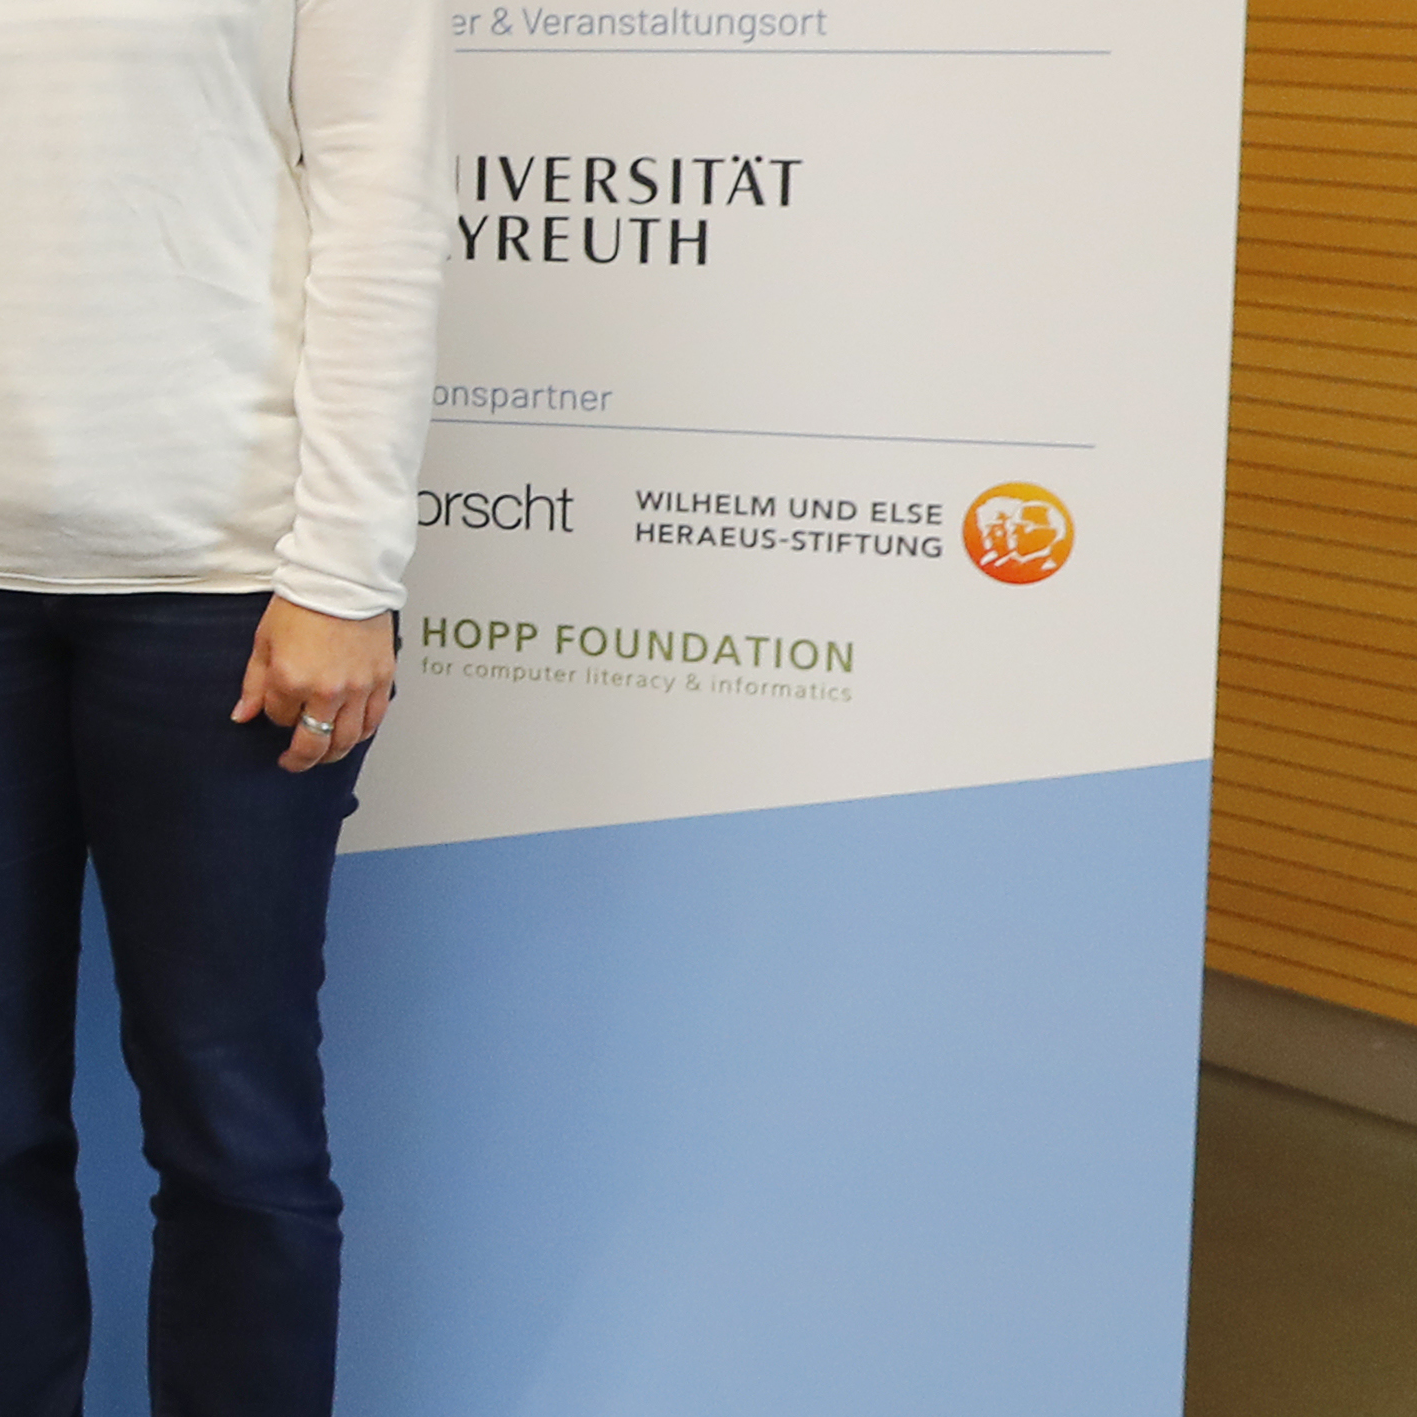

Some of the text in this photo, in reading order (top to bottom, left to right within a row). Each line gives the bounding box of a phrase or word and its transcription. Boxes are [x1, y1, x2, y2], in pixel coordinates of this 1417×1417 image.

[490, 6, 514, 36] &
[521, 6, 828, 44] Veranstaltungsort
[456, 154, 802, 207] IVERSITÄT
[458, 214, 708, 266] YREUTH
[432, 384, 613, 414] onspartner
[635, 489, 943, 525] WILHELM UND ELSE
[635, 522, 944, 559] HERAEUS-STIFTUNG
[422, 616, 855, 673] HOPP FOUNDATION
[421, 656, 854, 703] for computer literacy & informatics
